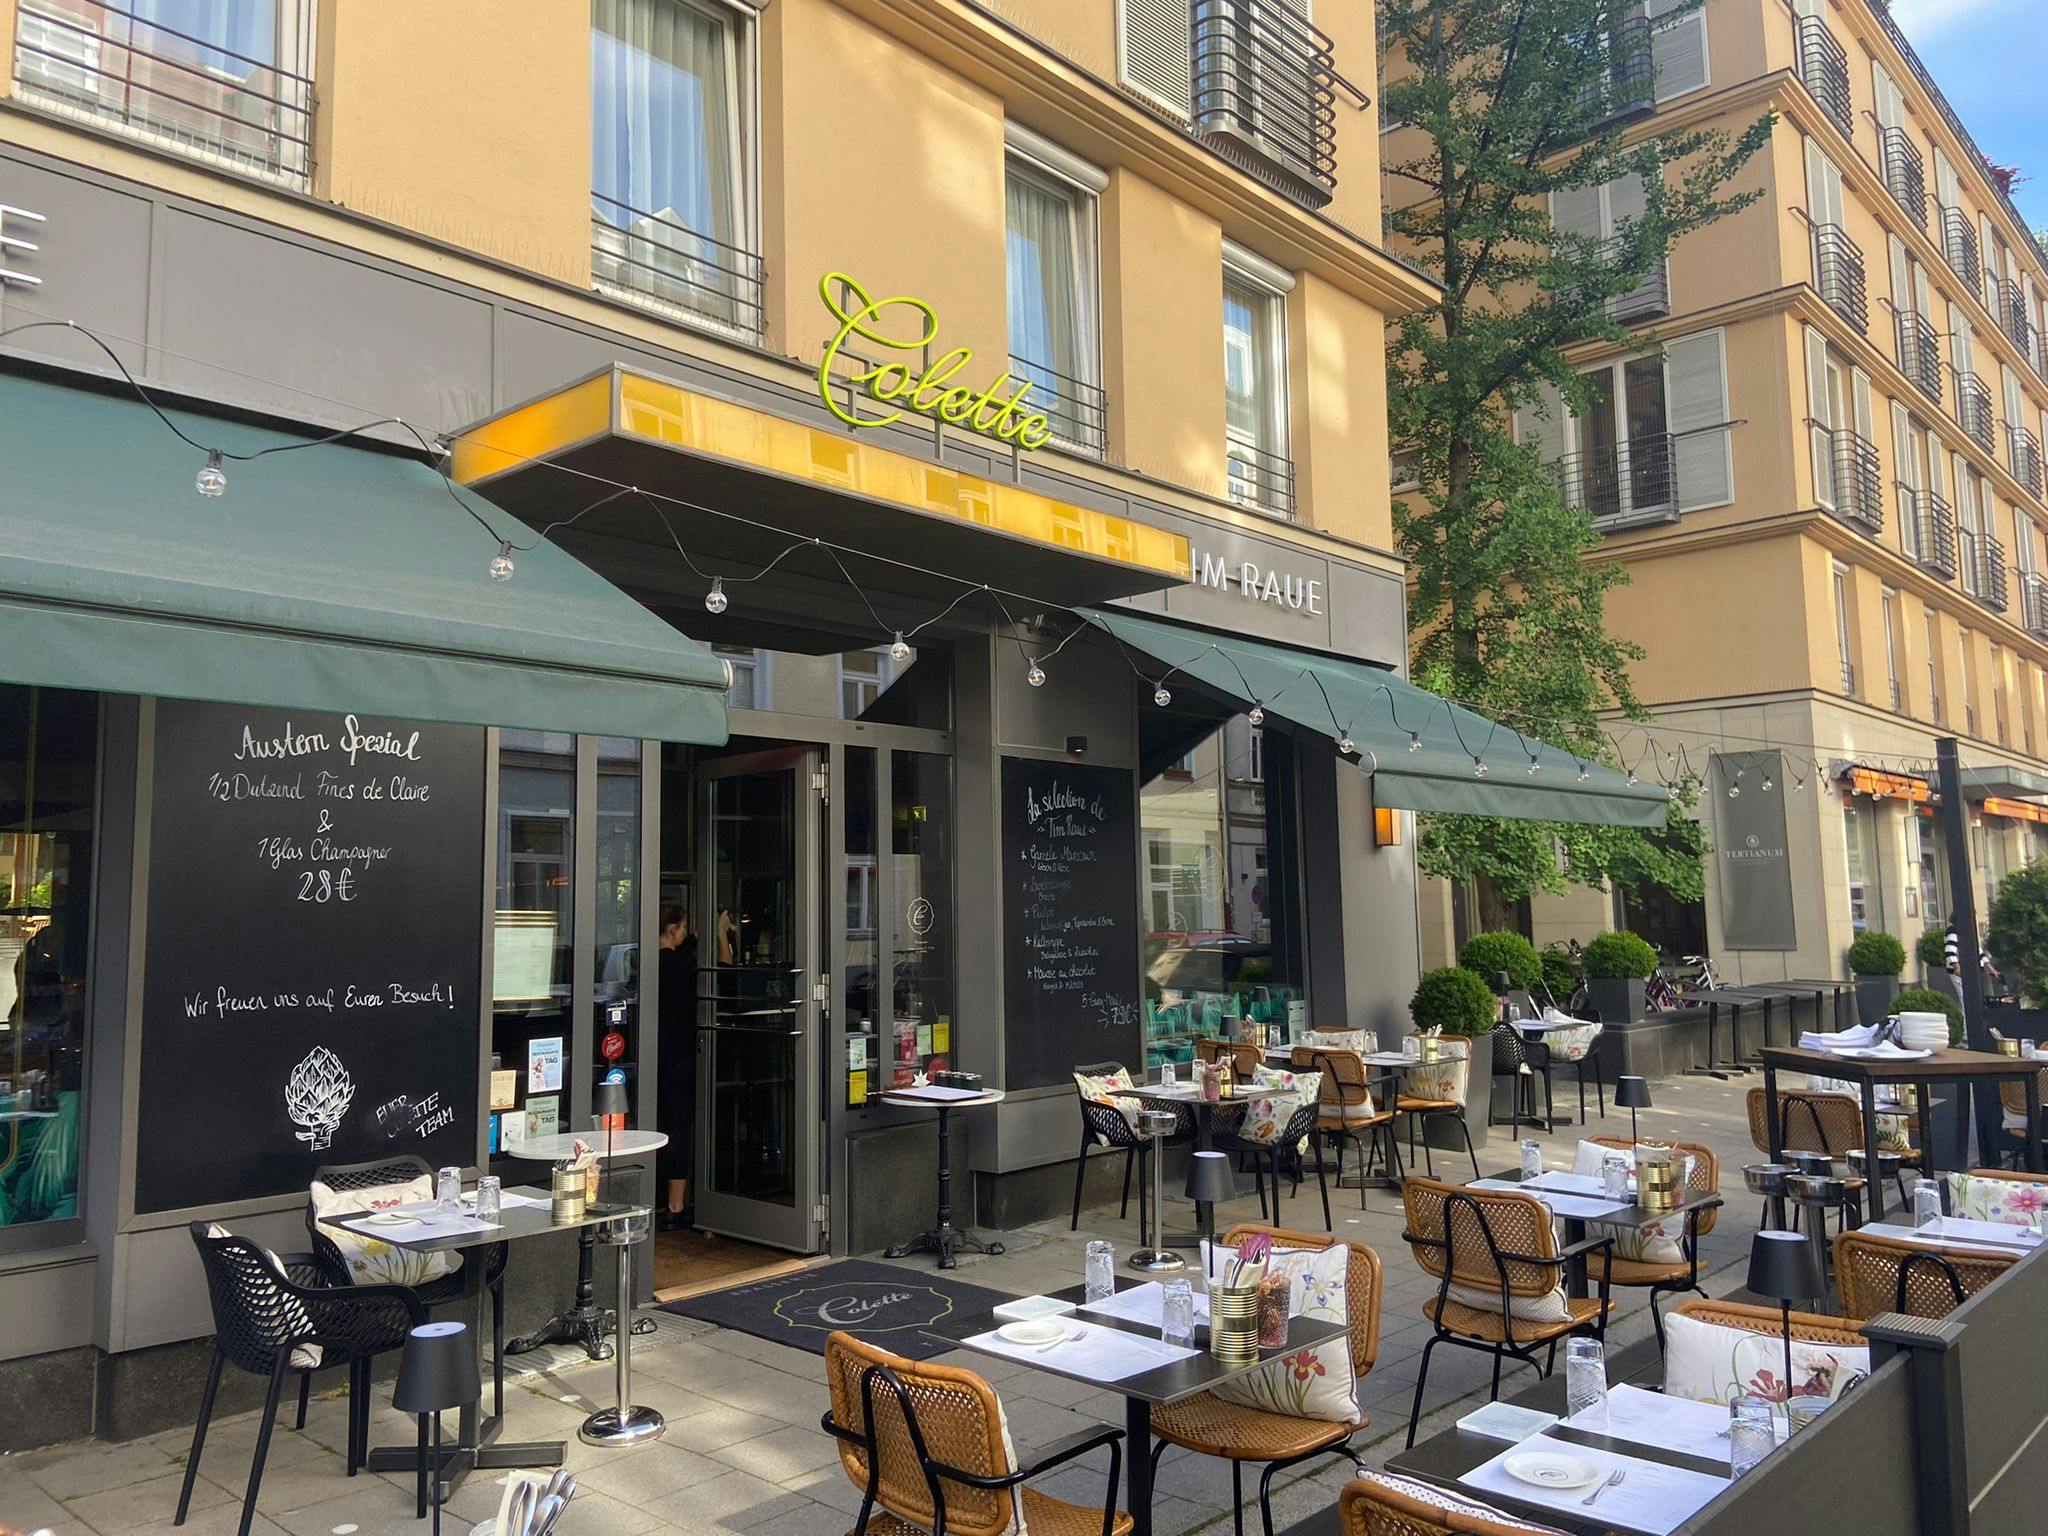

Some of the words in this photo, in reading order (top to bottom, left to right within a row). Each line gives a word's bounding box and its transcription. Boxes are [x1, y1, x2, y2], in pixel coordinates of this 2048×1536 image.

[817, 272, 1052, 451] Colette
[1241, 562, 1322, 615] RAUE
[234, 721, 330, 760] Austern
[340, 713, 422, 766] Spezial
[362, 777, 384, 800] de
[389, 776, 431, 802] Claire
[316, 808, 334, 834] &
[1091, 794, 1107, 822] de
[310, 837, 393, 870] Champagner
[1726, 848, 1784, 859] TERTIANUM
[296, 866, 358, 903] 28€
[184, 995, 209, 1019] Wir
[216, 984, 268, 1018] freuen
[273, 991, 299, 1010] uns
[305, 988, 335, 1012] auf
[415, 1106, 455, 1138] TEAM
[794, 1290, 913, 1325] Colette
